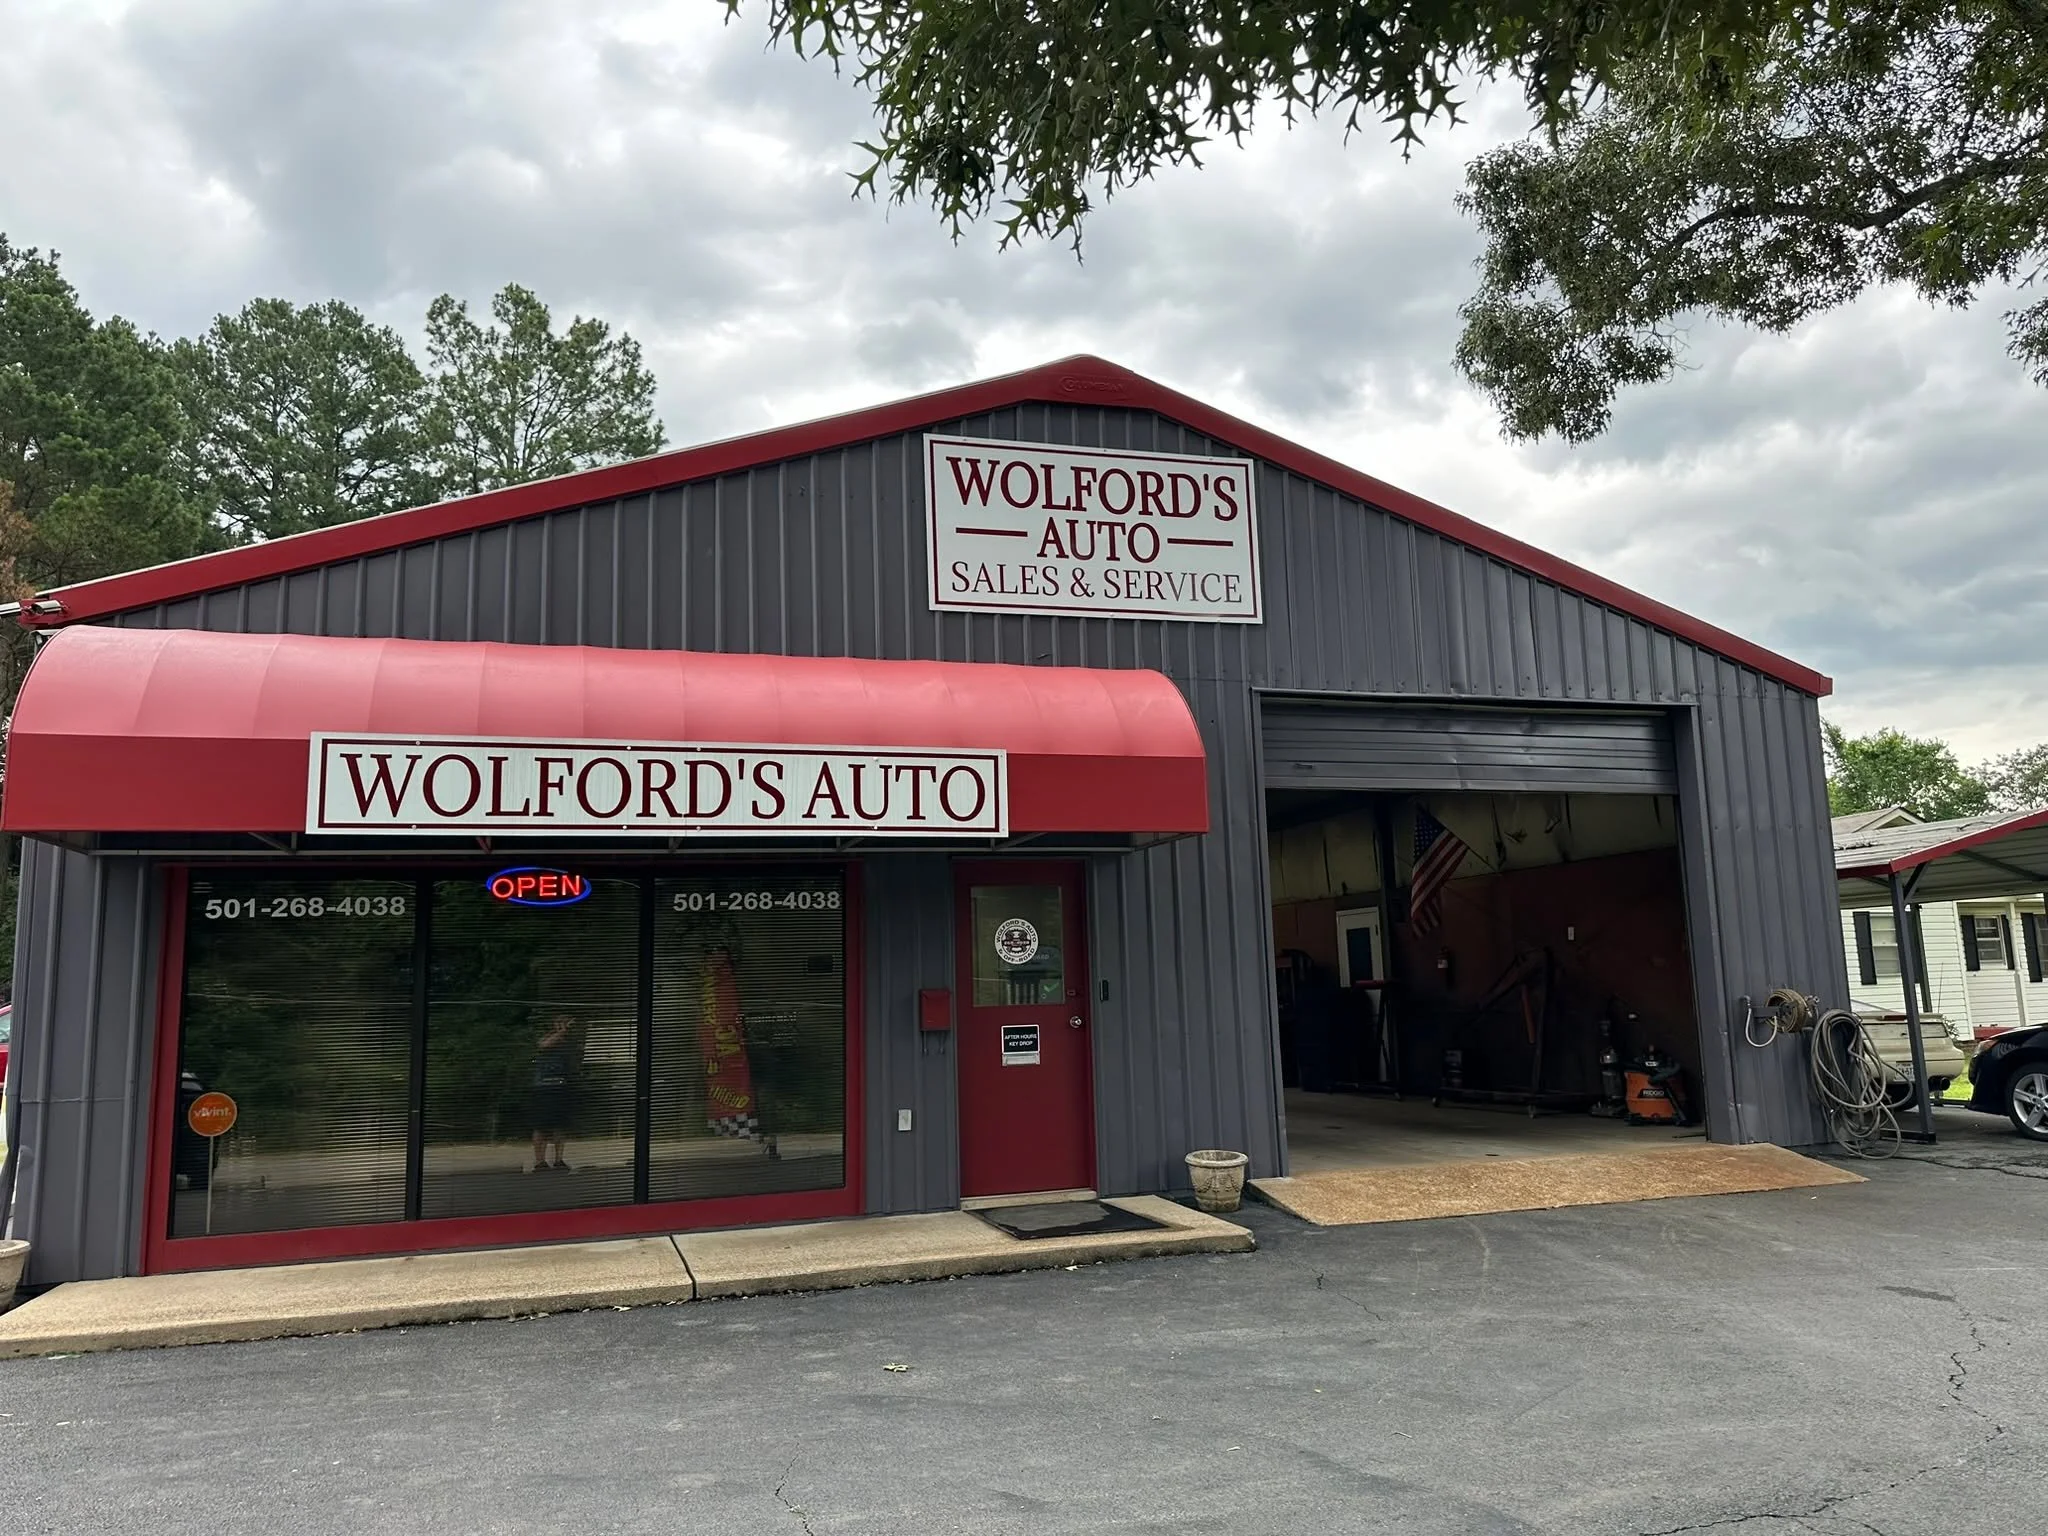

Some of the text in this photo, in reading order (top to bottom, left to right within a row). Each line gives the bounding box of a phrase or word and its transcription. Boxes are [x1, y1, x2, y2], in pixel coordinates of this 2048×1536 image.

[945, 456, 1238, 521] WOLFORD'S
[1036, 516, 1160, 563] AUTO
[951, 561, 1242, 602] SALES & SERVICE
[339, 753, 986, 822] WOLFORD'S AUTO
[492, 875, 580, 898] OPEN
[673, 891, 841, 912] 501-268-4038
[205, 896, 406, 919] 501-268-4038
